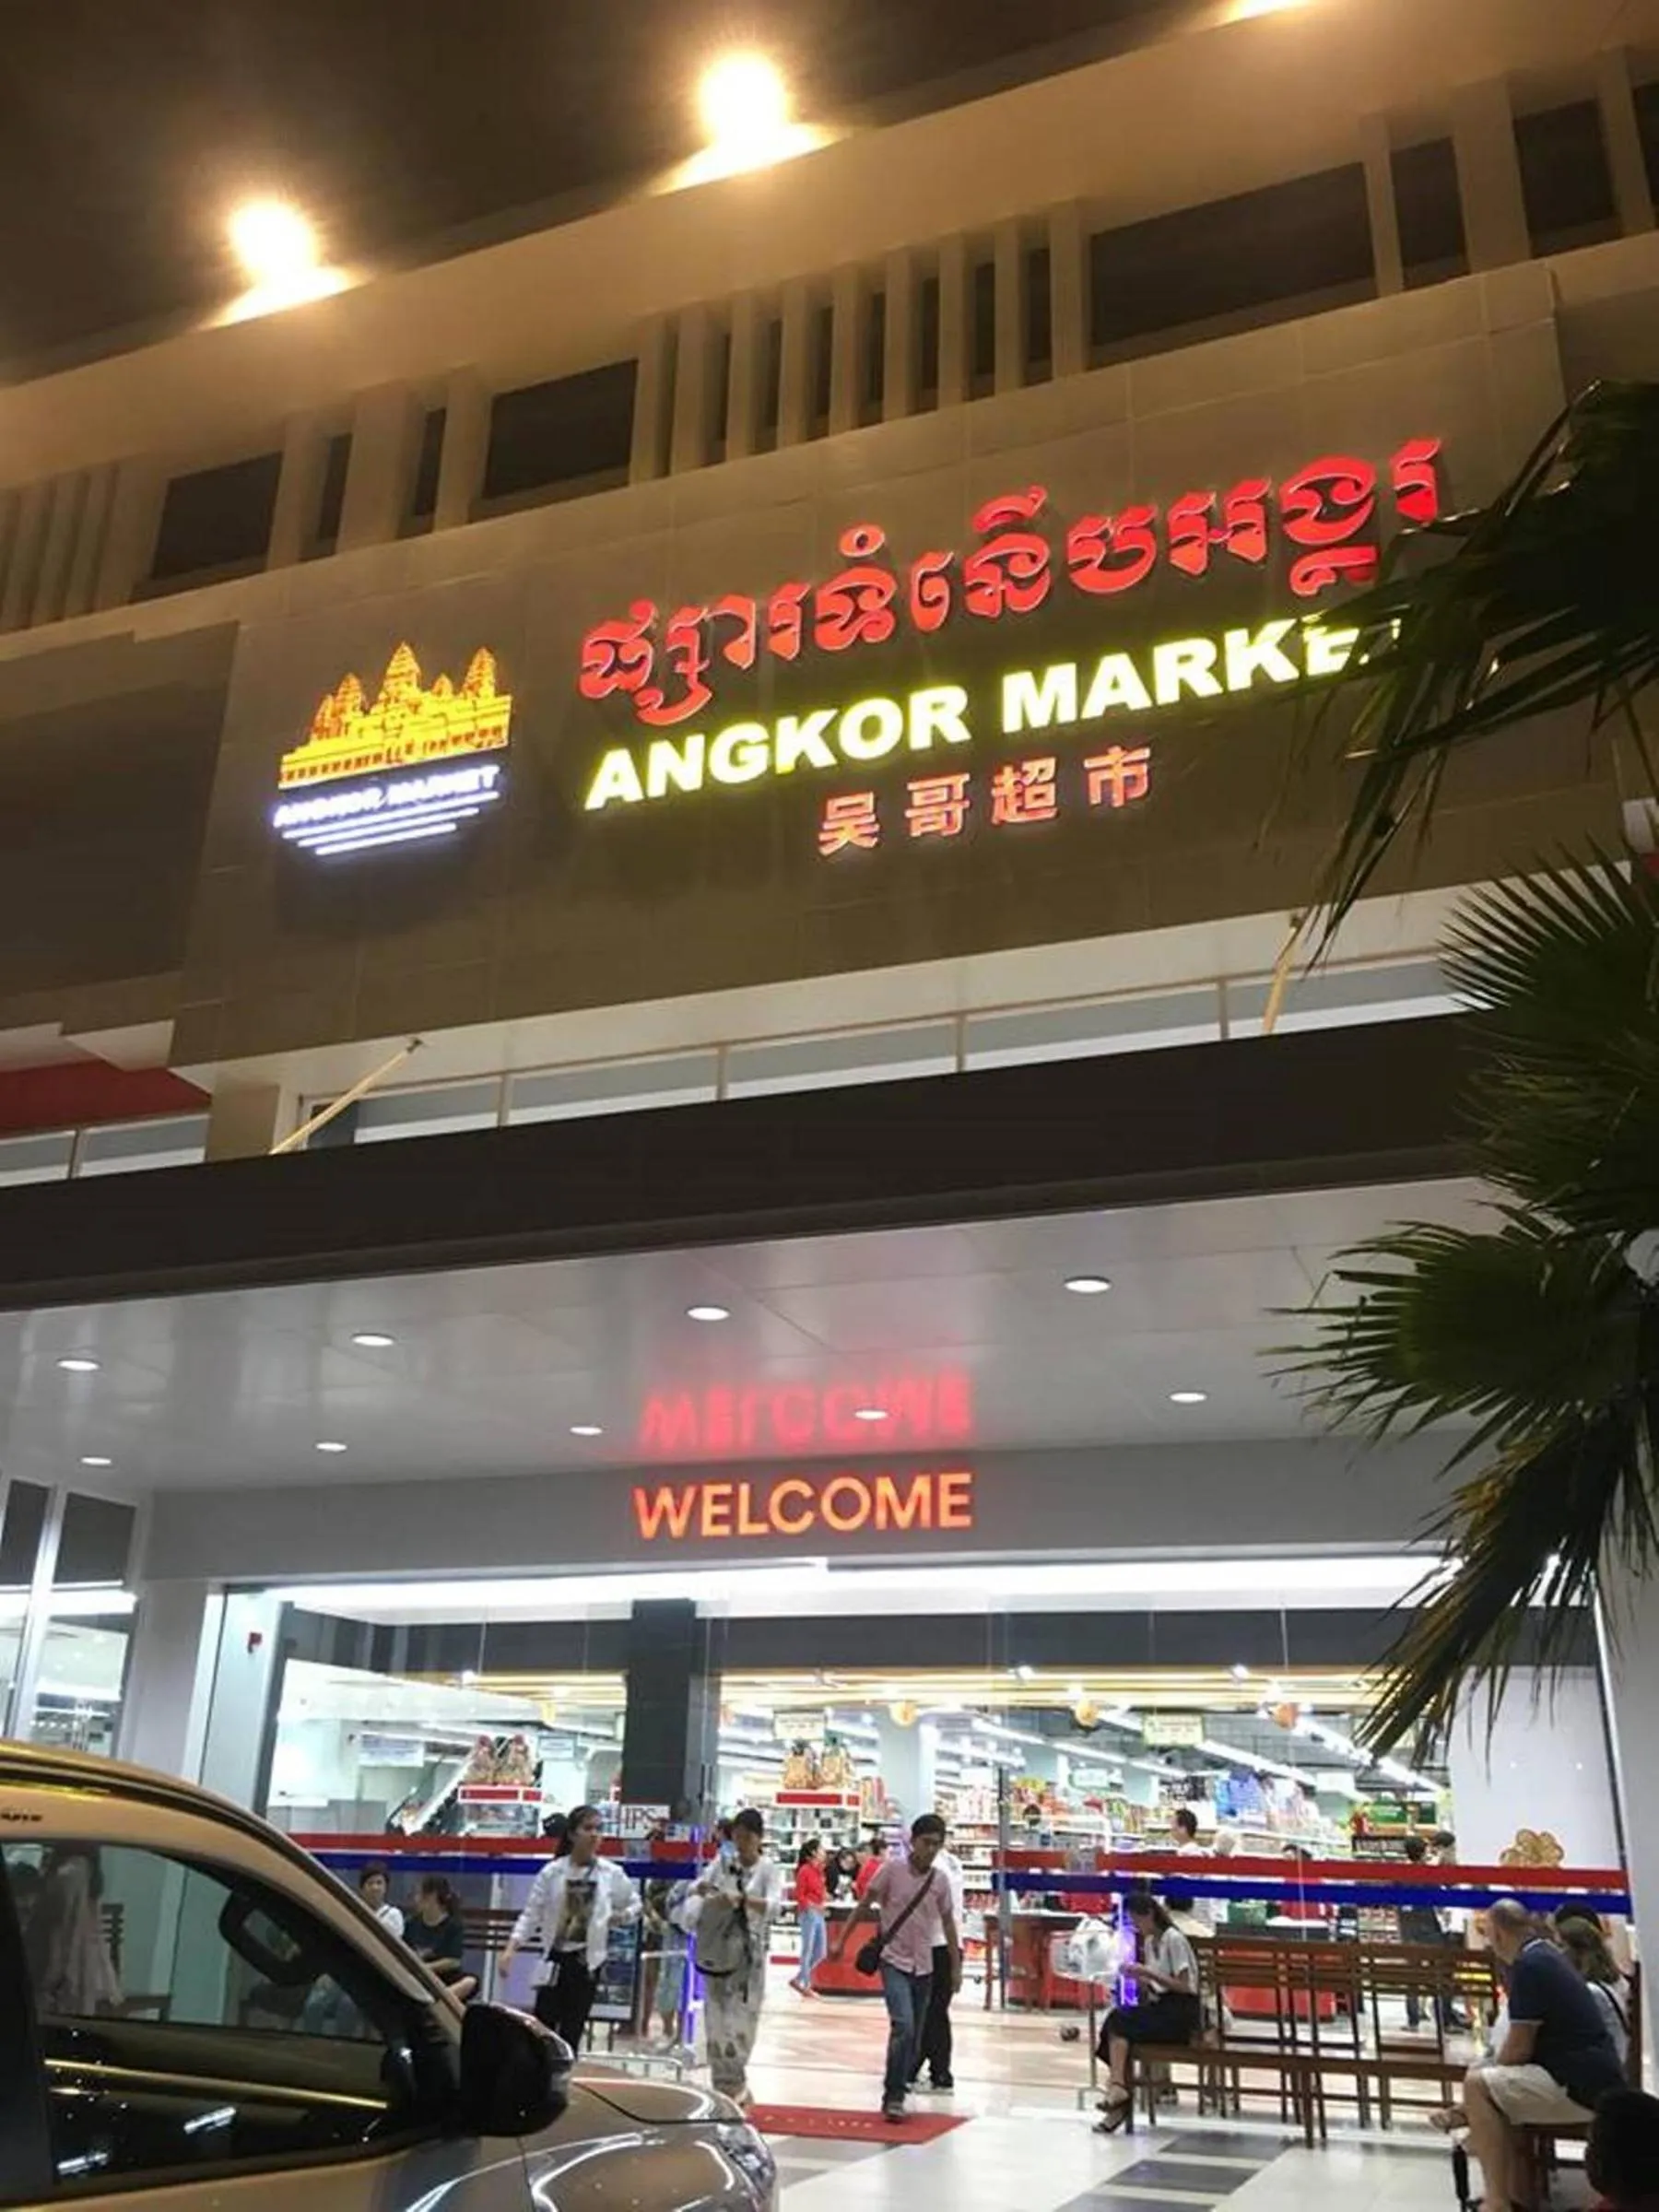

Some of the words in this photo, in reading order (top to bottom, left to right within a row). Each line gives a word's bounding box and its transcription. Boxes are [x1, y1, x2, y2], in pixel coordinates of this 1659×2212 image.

[585, 686, 971, 810] ANGKOR
[1003, 612, 1402, 733] MARKE
[818, 745, 1151, 855] 吴哥超市
[634, 1473, 972, 1539] WELCOME
